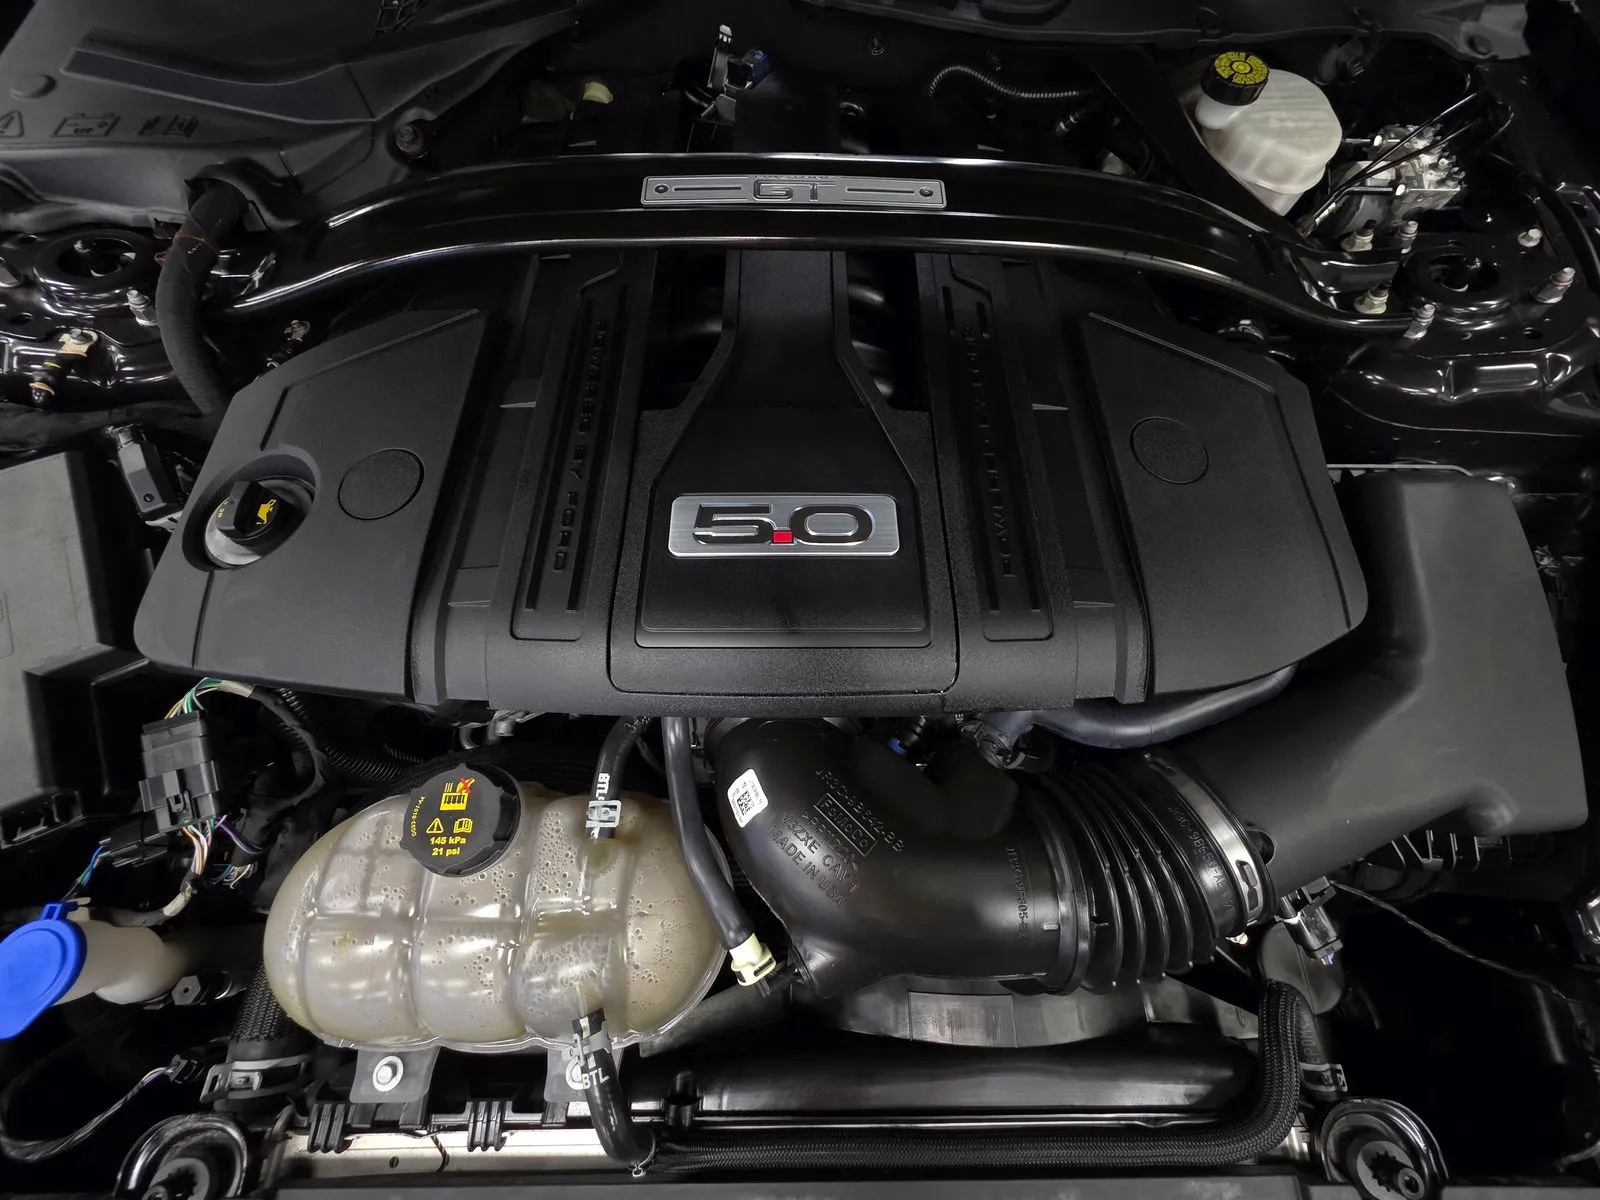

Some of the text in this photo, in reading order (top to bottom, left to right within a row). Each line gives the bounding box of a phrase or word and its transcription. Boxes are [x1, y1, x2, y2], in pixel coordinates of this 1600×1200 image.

[753, 180, 836, 202] GT
[553, 491, 581, 571] FORD
[692, 503, 876, 546] 5.0
[595, 773, 611, 798] BTL
[820, 798, 869, 849] FoMoCo
[430, 836, 467, 845] 145 kPa
[432, 847, 460, 857] 21 psi
[768, 824, 846, 906] MADE IN USA
[582, 1067, 610, 1089] BTL
